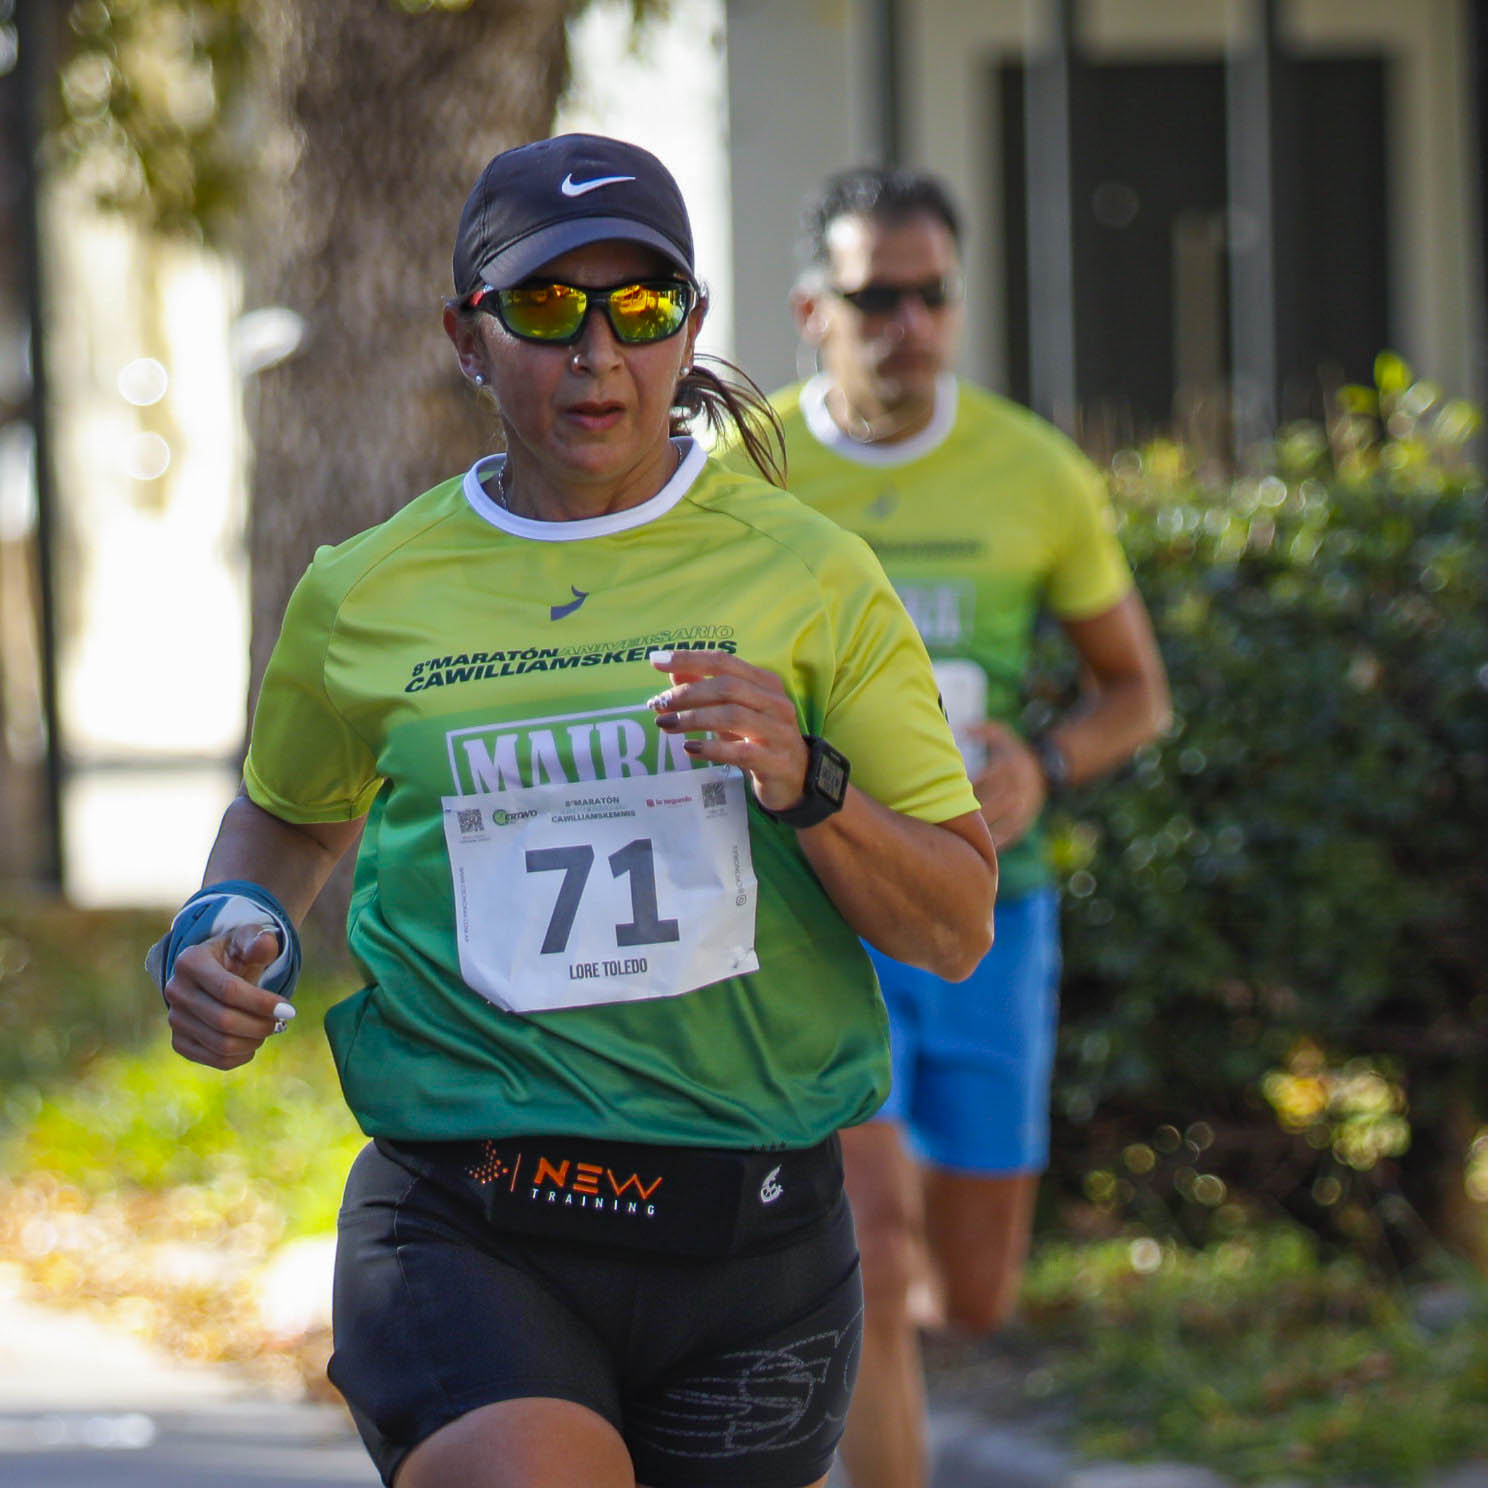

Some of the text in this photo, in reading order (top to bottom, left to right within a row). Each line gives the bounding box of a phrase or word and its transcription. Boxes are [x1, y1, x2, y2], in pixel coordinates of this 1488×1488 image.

[525, 838, 680, 955] 71
[569, 957, 648, 980] LORE TOLEDO
[533, 1156, 663, 1200] NEW
[531, 1188, 656, 1216] TRAINING
